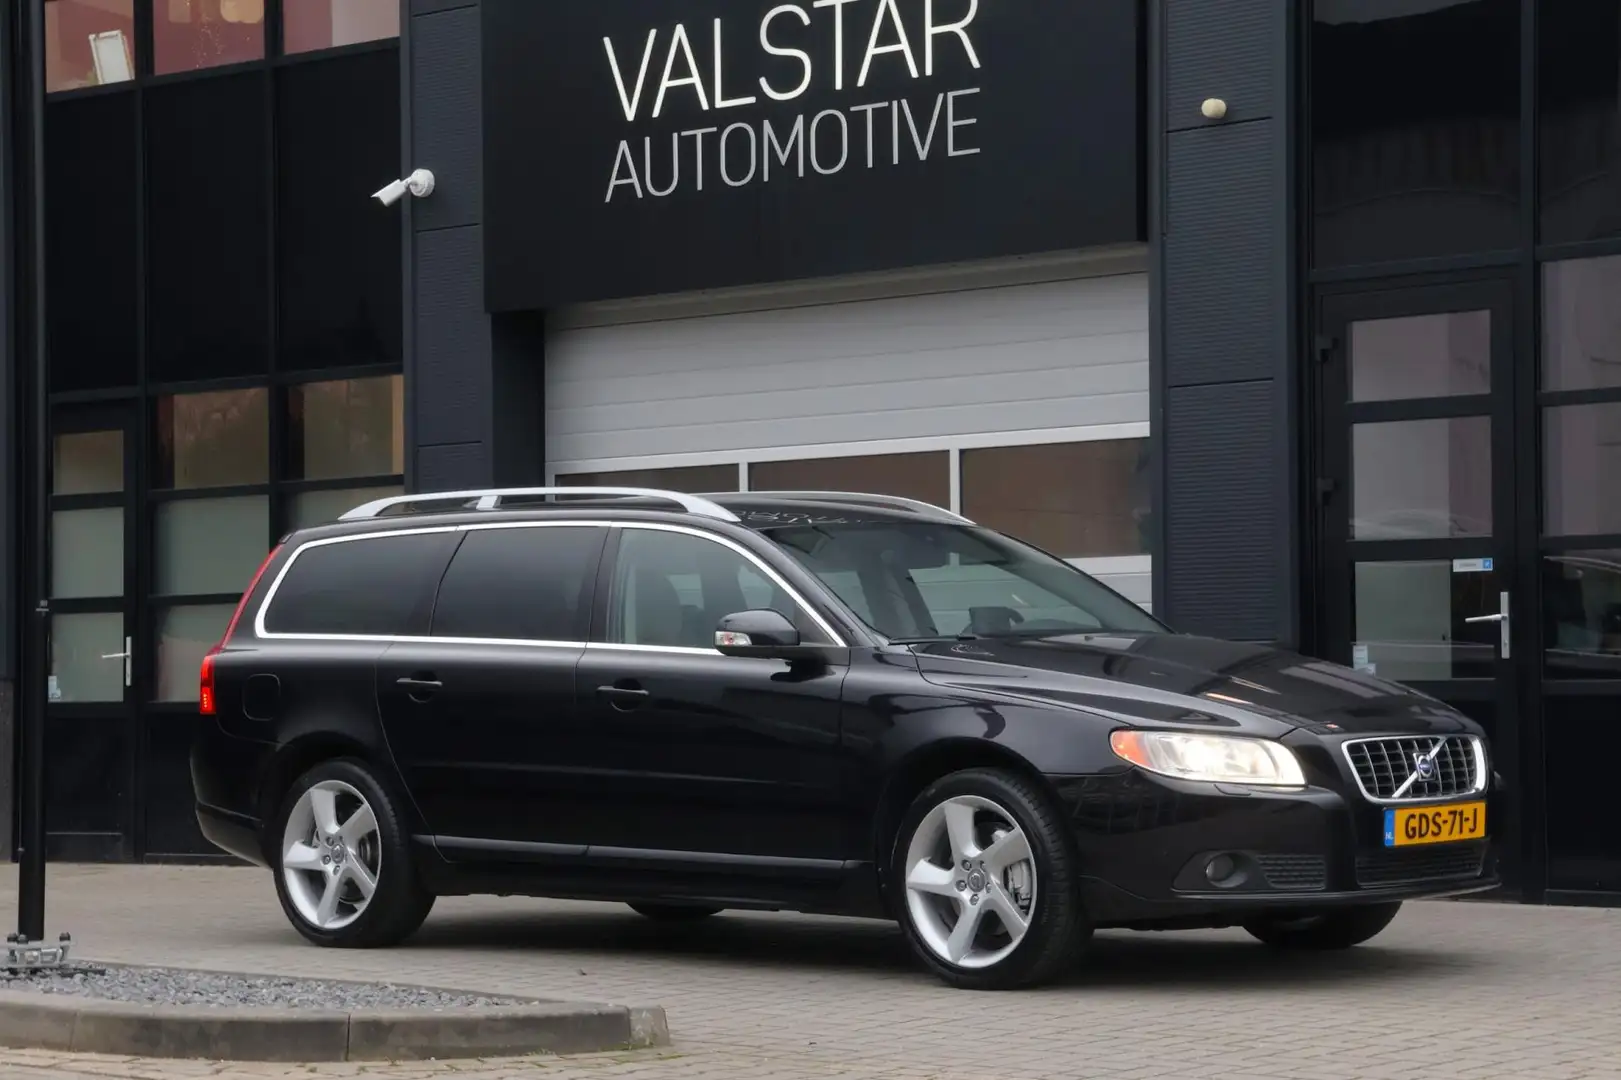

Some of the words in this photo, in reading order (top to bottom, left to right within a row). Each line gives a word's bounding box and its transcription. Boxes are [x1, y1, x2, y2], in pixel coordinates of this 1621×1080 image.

[603, 0, 981, 121] VALSTAR
[605, 87, 980, 203] AUTOMOTIVE
[1405, 808, 1478, 839] GDS-71-J
